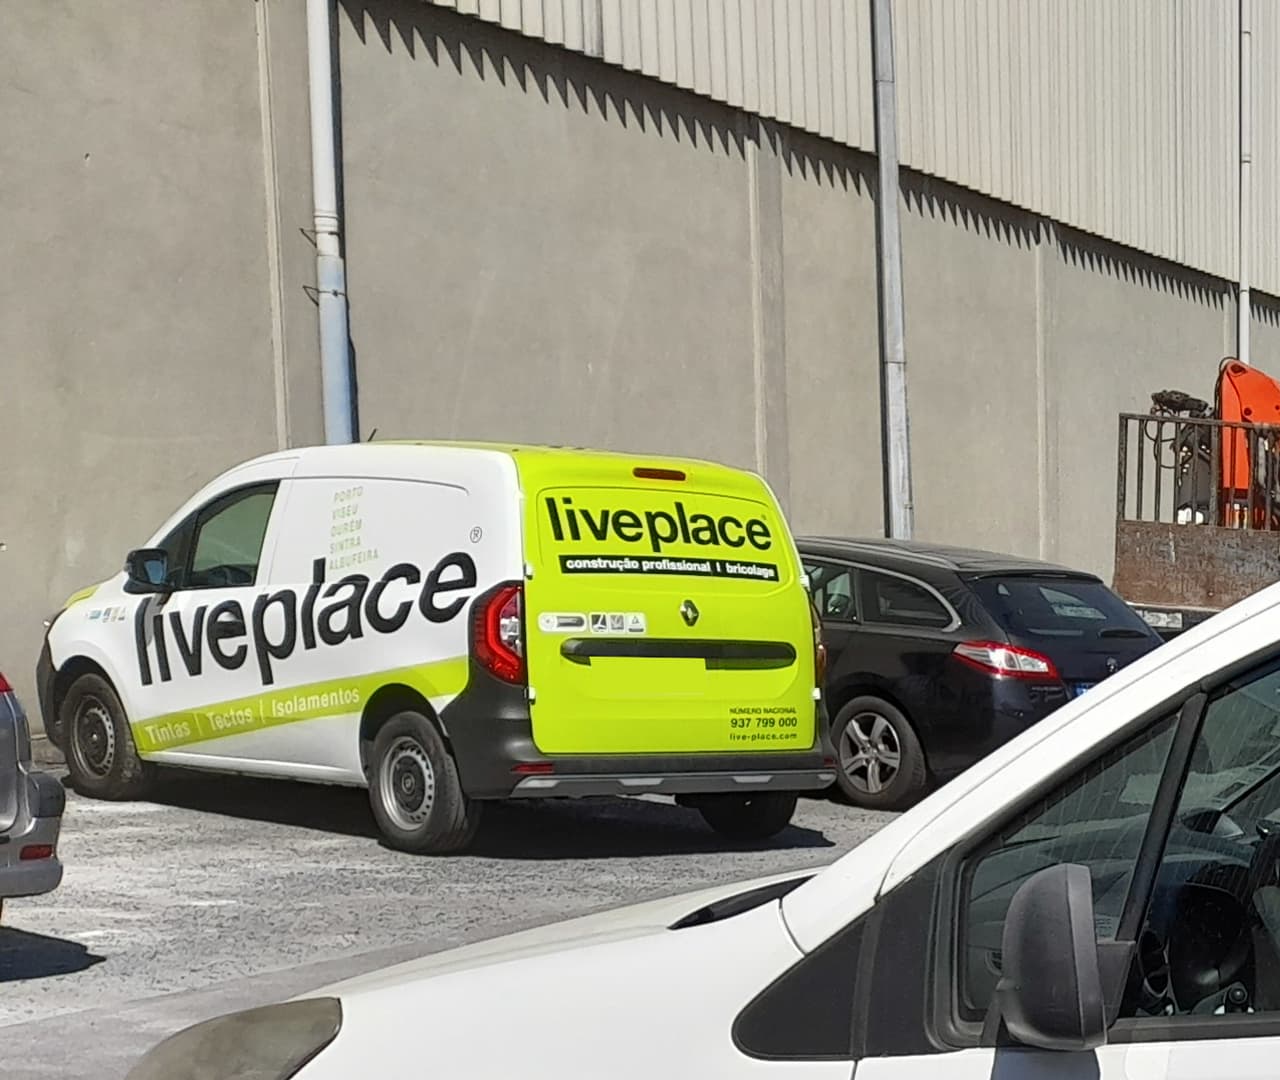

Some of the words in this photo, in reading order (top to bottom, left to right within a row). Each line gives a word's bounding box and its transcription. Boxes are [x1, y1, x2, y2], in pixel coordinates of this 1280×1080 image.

[334, 486, 363, 503] PORTO
[545, 497, 772, 552] liveplace
[330, 536, 361, 554] SINTRA
[566, 557, 640, 572] construção
[642, 559, 711, 573] profissional
[725, 562, 775, 578] bricolage
[134, 552, 478, 686] liveplace
[144, 722, 191, 745] Tintas
[207, 707, 254, 731] Tectos
[271, 686, 361, 718] Isolamentos
[730, 717, 752, 729] 937
[755, 717, 776, 728] 799
[778, 716, 798, 728] 000
